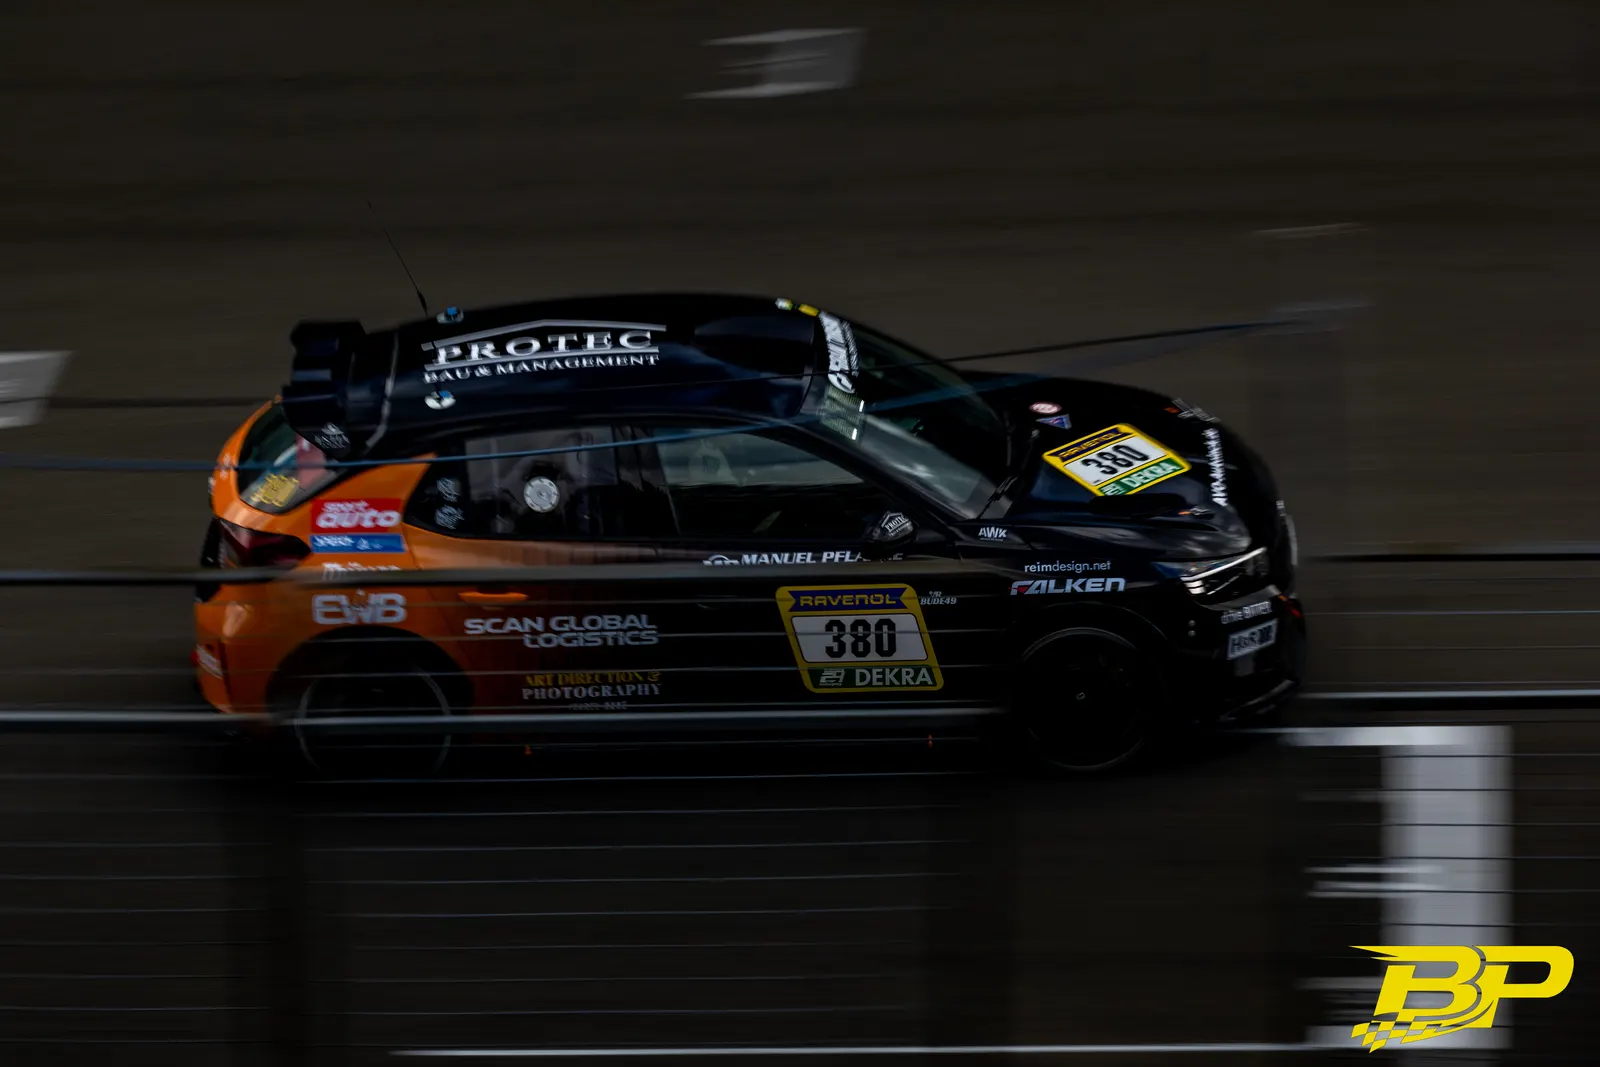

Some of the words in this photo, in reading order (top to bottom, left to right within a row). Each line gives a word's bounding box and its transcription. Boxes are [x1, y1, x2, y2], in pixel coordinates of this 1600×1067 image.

[433, 330, 652, 366] PROTEC
[496, 355, 660, 376] MANAGEMENT
[1081, 444, 1150, 476] 380
[1121, 459, 1180, 490] DEKRA
[315, 508, 402, 530] auto
[978, 526, 1008, 538] AWK
[740, 551, 817, 565] MANUEL
[1024, 560, 1112, 574] reimdesign.net
[1010, 577, 1127, 596] FALKEN
[799, 592, 897, 607] RAVENOL
[463, 616, 545, 635] SCAN
[549, 613, 658, 632] GLOBAL
[523, 629, 660, 649] LOGISTICS
[825, 618, 897, 658] 380
[525, 672, 553, 687] ART
[557, 671, 644, 687] DIRECTION
[855, 667, 933, 686] DEKRA
[521, 682, 662, 701] PHOTOGRAPHY
